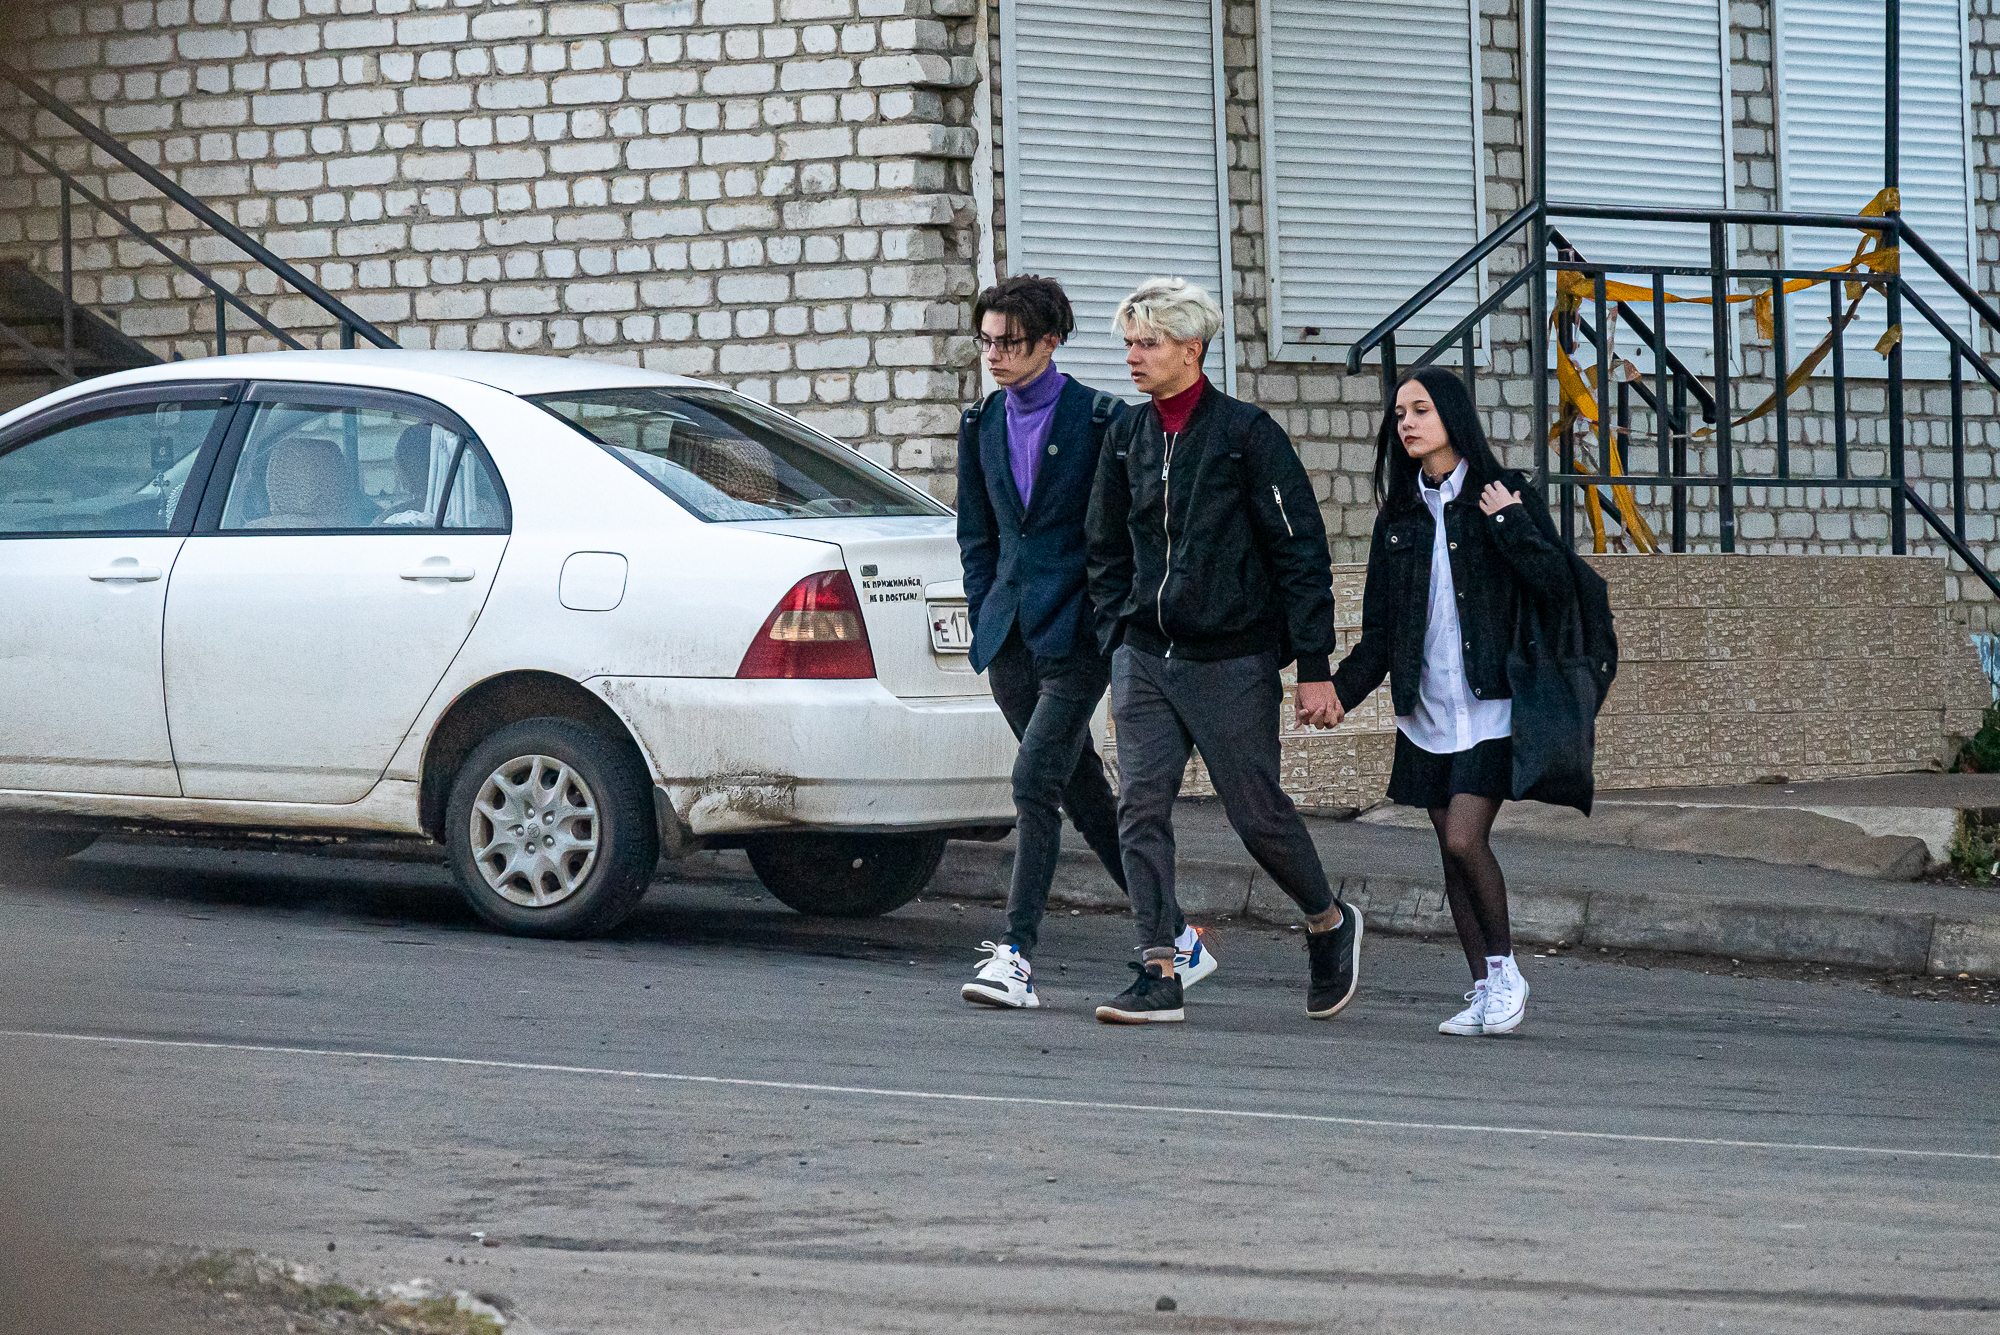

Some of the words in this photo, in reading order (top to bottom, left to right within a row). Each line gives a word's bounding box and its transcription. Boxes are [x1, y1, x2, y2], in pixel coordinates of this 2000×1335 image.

[862, 580, 870, 589] НЕ
[869, 594, 877, 602] НЕ
[879, 594, 884, 602] В
